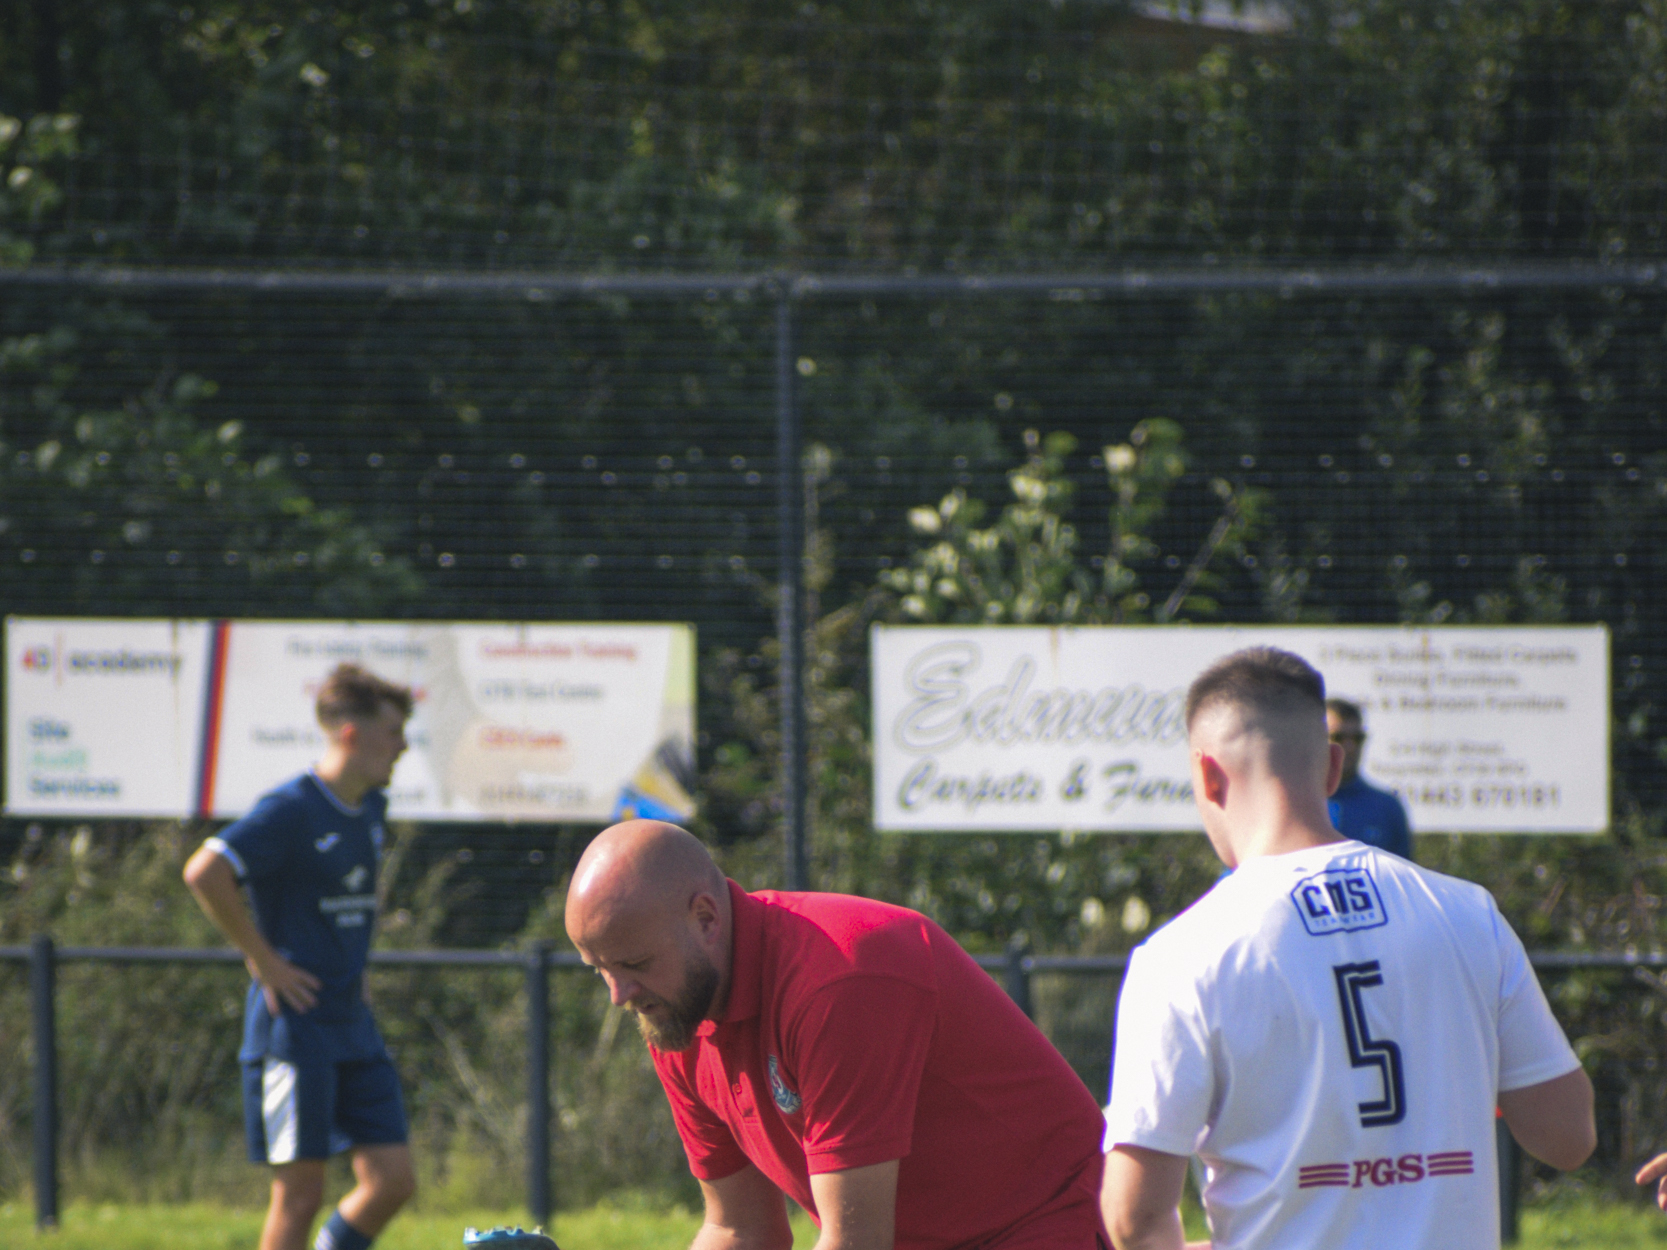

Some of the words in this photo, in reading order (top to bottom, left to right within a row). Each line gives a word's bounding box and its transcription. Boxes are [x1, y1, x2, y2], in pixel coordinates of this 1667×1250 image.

[69, 650, 181, 677] academy
[30, 719, 69, 740] Site
[30, 777, 119, 797] Services
[898, 757, 1042, 815] Carpets
[1060, 757, 1090, 800] &
[1332, 960, 1407, 1128] 5
[1351, 1153, 1425, 1188] PGS
